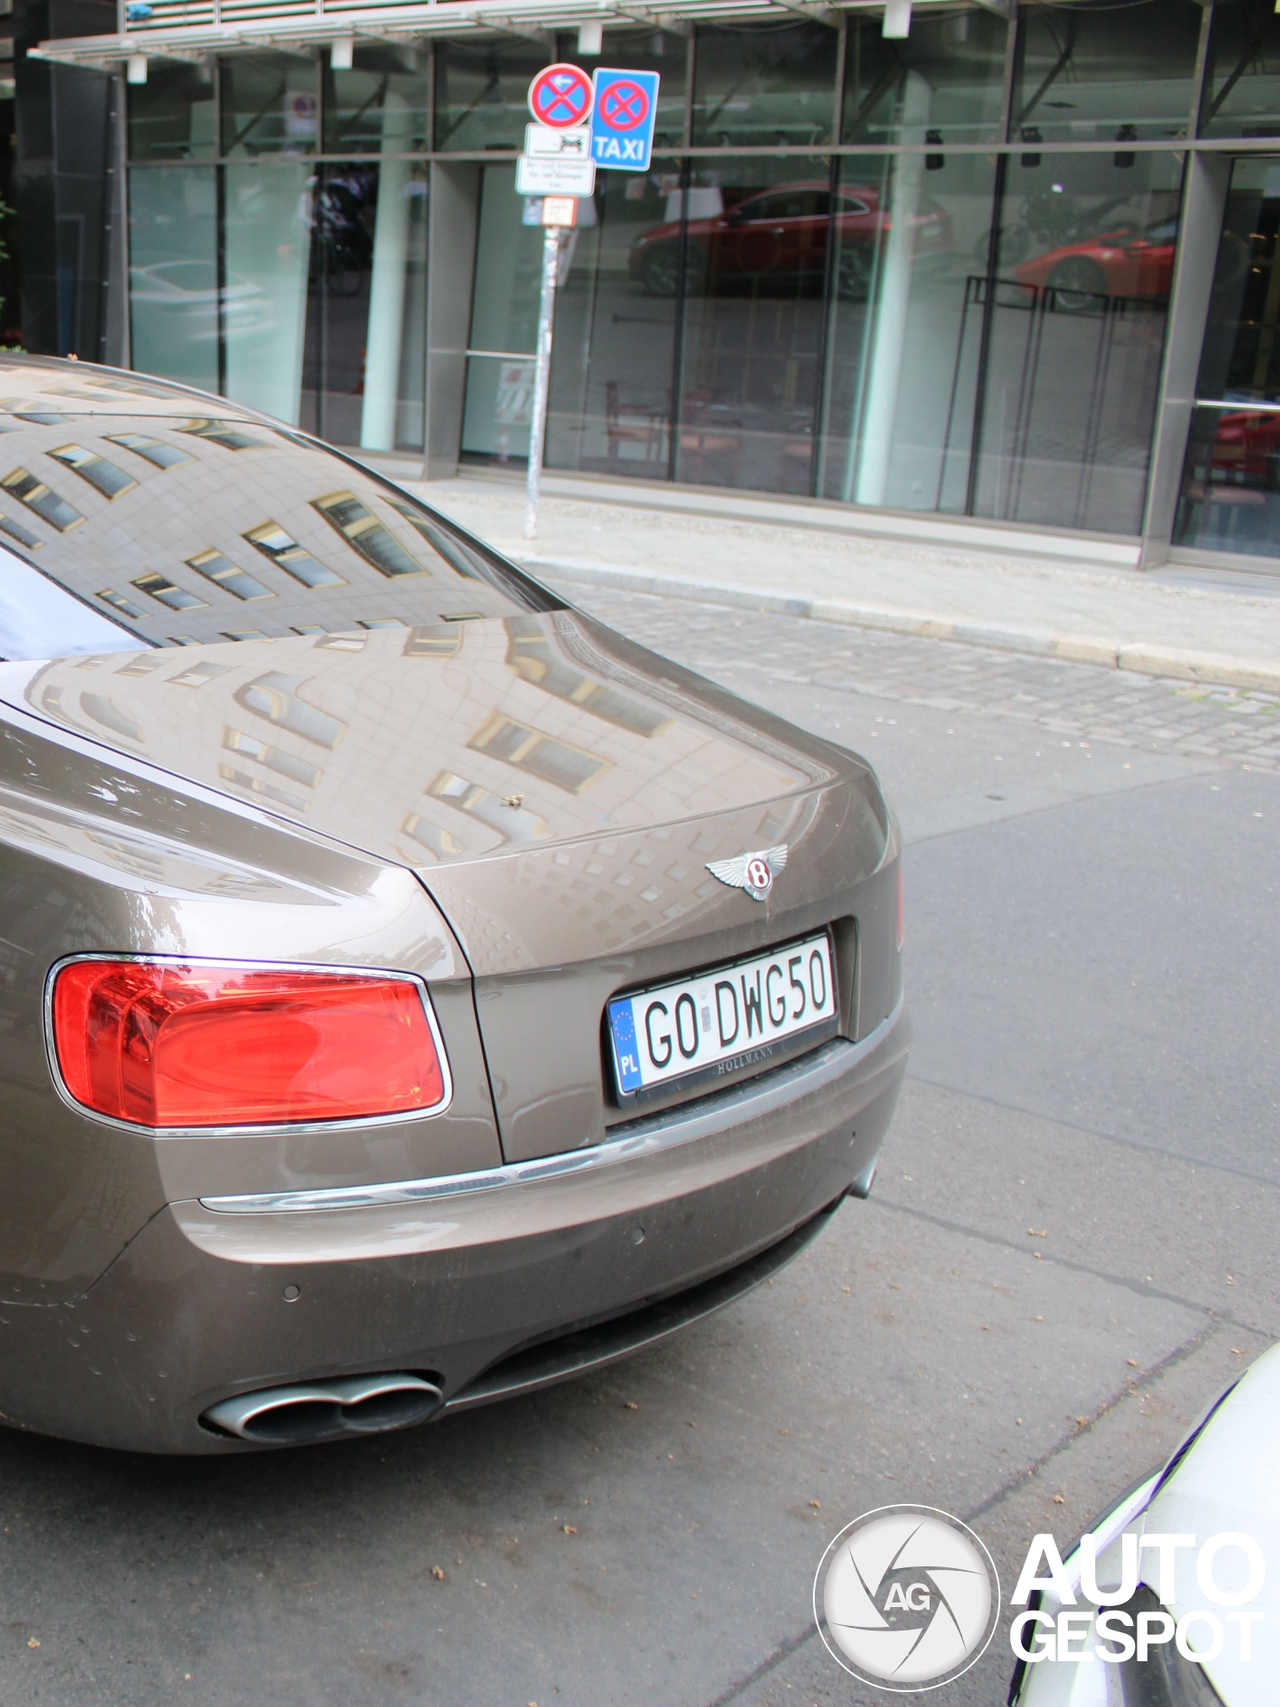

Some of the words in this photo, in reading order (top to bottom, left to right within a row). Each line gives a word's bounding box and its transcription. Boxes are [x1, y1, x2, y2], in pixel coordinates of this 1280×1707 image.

[594, 136, 645, 160] TAXI
[645, 993, 699, 1068] GO
[714, 950, 826, 1048] DWG50
[621, 1055, 638, 1076] PL
[718, 1046, 773, 1074] HOLLMANN
